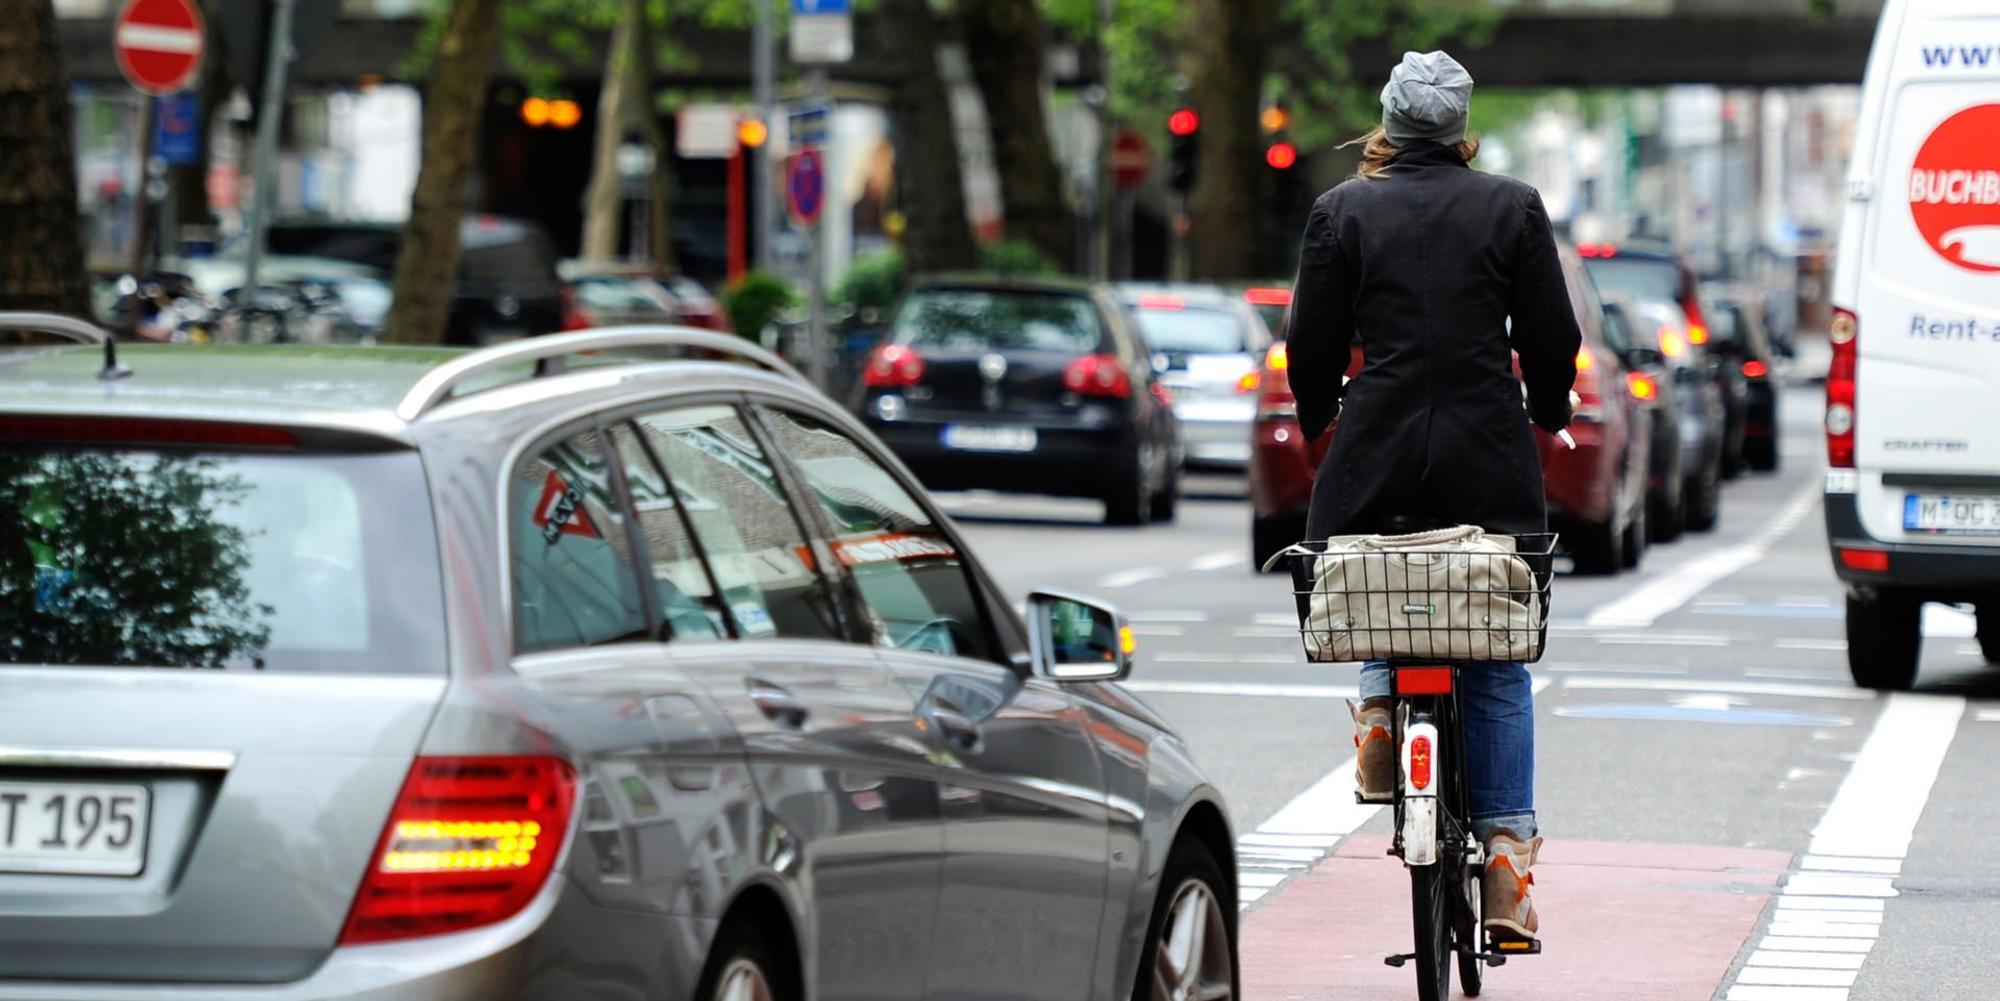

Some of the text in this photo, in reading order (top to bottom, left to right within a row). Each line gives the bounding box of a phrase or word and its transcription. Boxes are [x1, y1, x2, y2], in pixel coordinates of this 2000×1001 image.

[1921, 46, 2000, 67] ww
[1, 793, 135, 848] T 195
